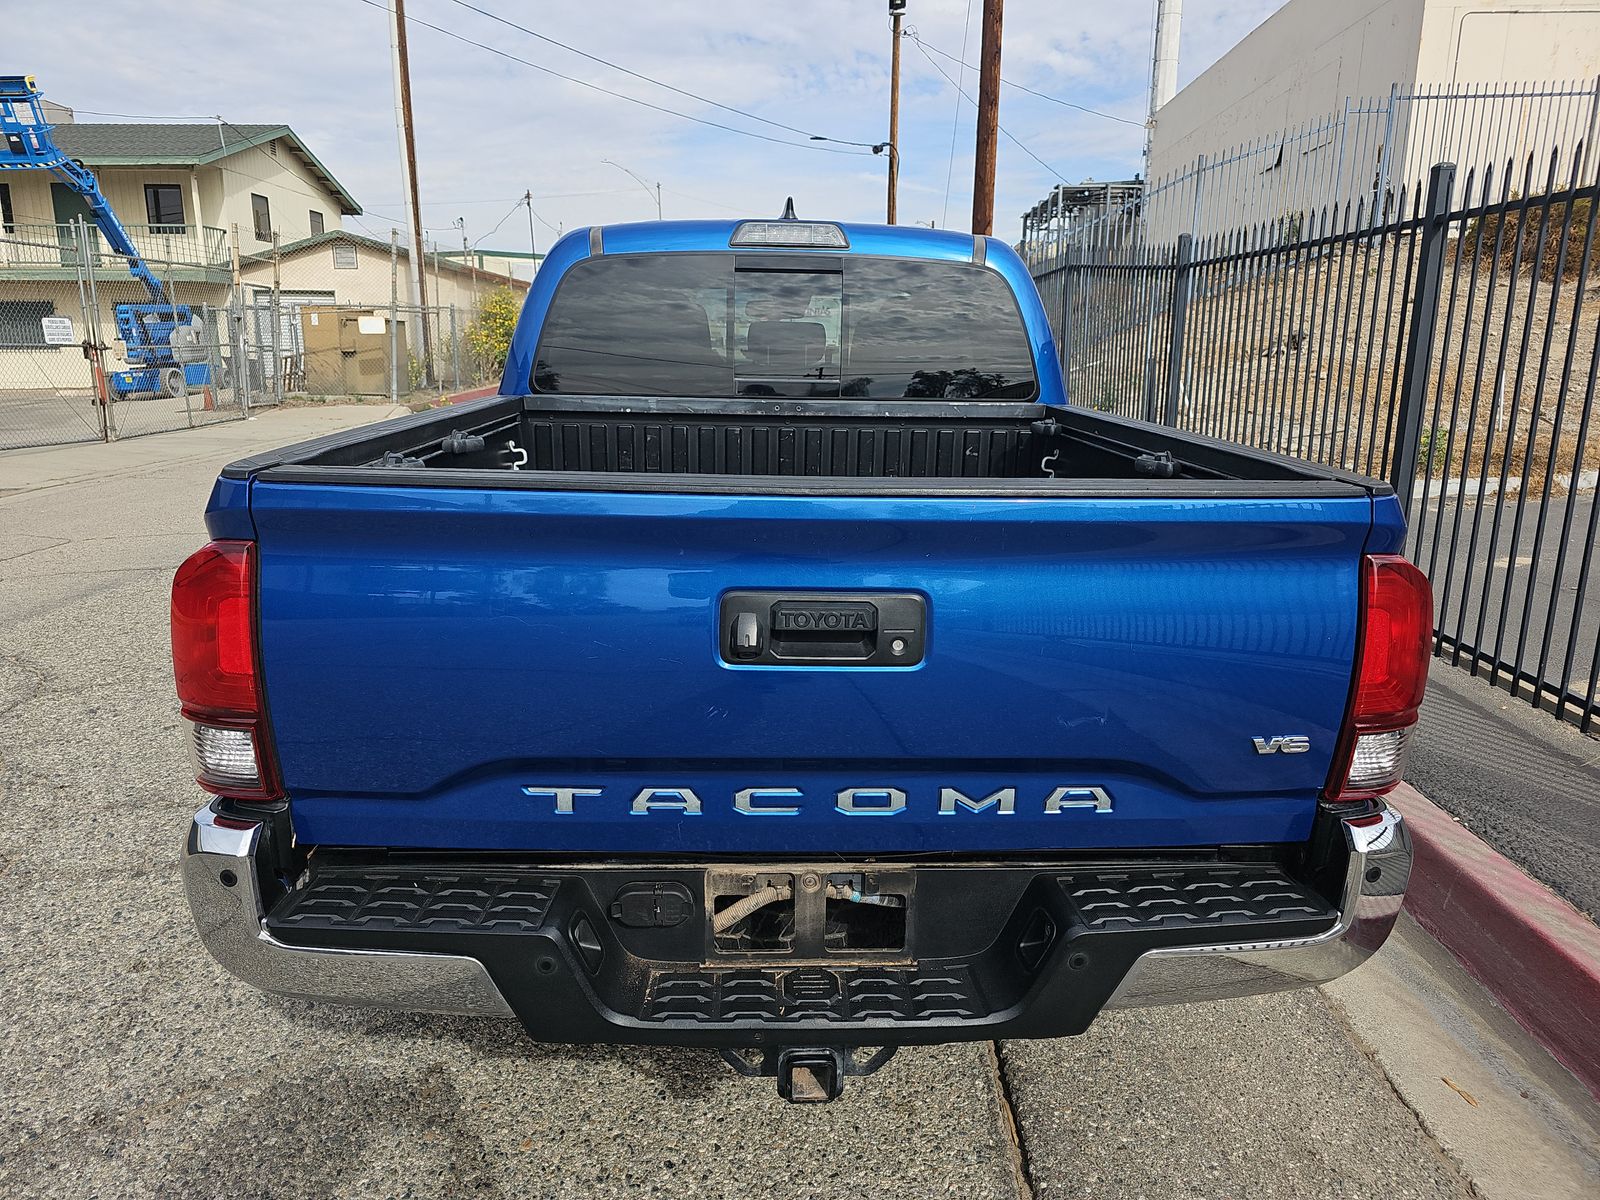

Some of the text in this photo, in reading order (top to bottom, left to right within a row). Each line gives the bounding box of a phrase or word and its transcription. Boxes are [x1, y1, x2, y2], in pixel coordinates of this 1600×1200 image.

[780, 611, 869, 629] TOYOTA
[1252, 735, 1310, 754] V6
[521, 786, 1113, 815] TACOMA
